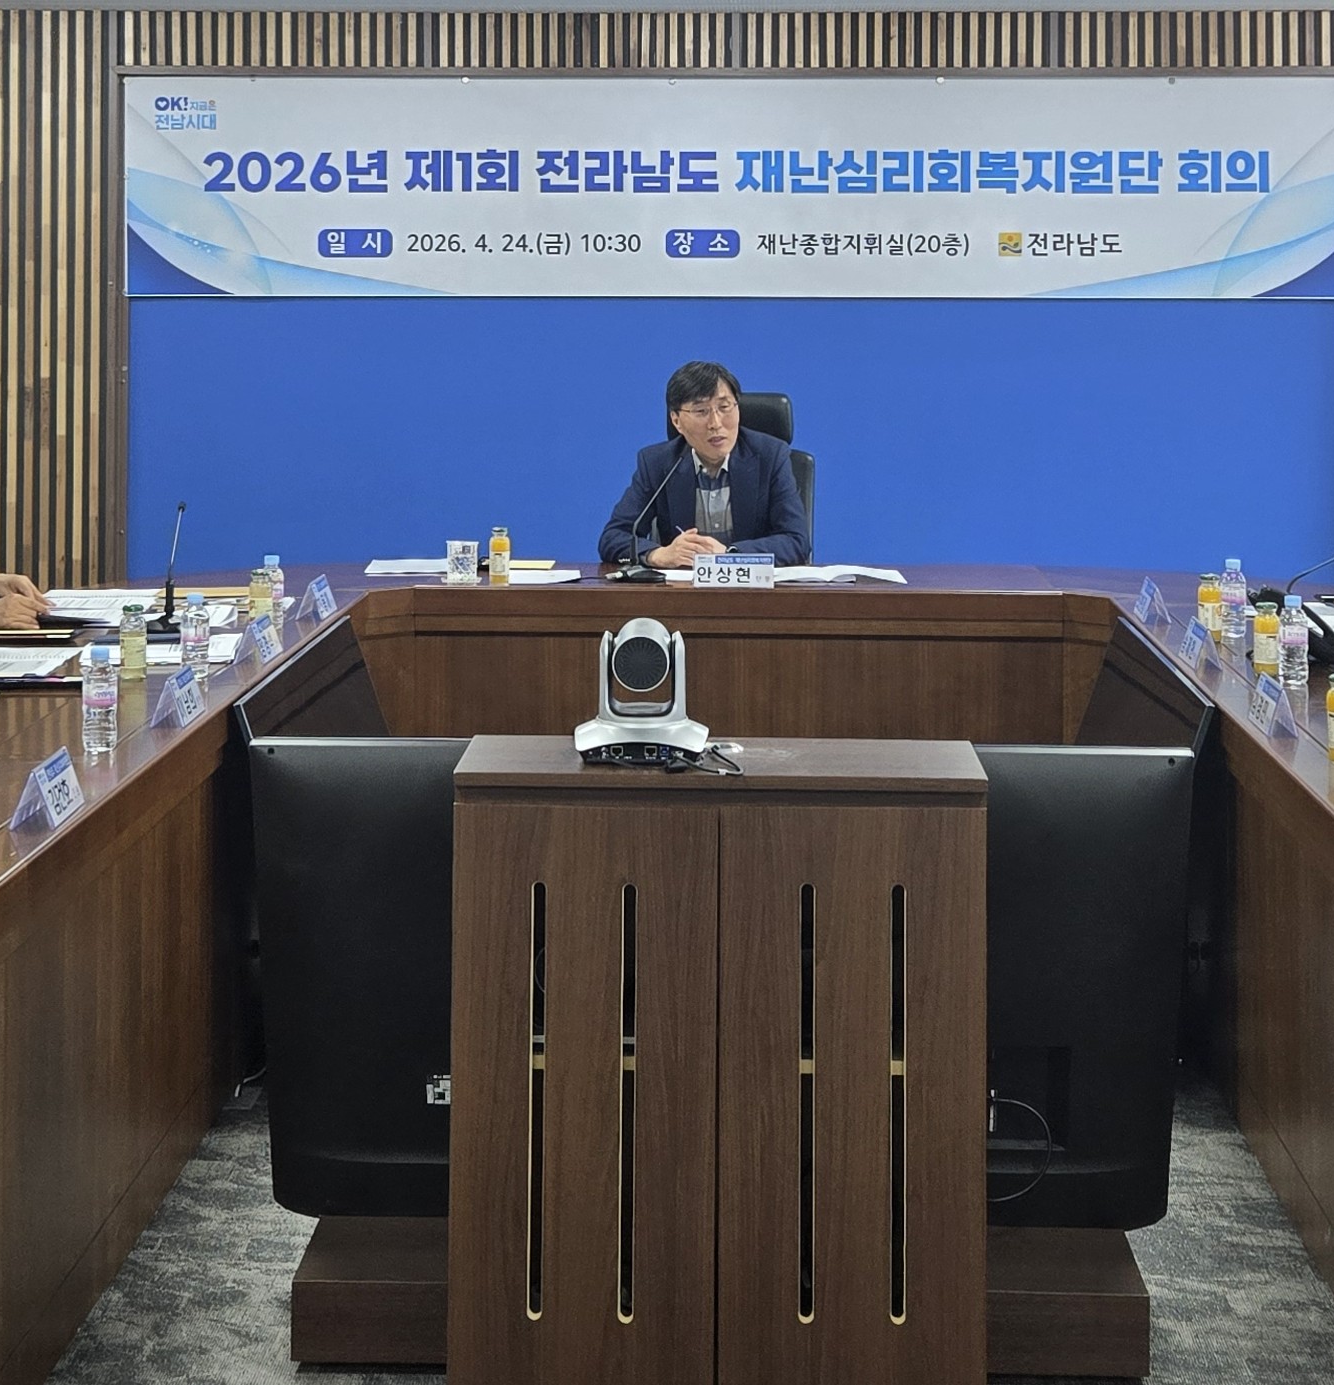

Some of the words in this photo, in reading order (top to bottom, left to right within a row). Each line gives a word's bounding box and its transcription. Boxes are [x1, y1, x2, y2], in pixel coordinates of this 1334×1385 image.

[154, 96, 188, 111] OK!
[189, 100, 216, 111] 지금은
[154, 113, 217, 130] 전남시대
[203, 150, 389, 193] 2026년
[404, 149, 520, 192] 제1회
[535, 149, 720, 193] 전라남도
[735, 149, 1163, 193] 재난심리회복지원단
[1177, 149, 1270, 193] 회의
[407, 233, 466, 254] 2026.
[474, 233, 493, 254] 4.
[501, 232, 571, 256] 24.(금)
[580, 233, 641, 253] 10:30
[756, 233, 970, 257] 재난종합지휘실(20층)
[1026, 232, 1123, 257] 전라남도
[697, 566, 751, 584] 안상현
